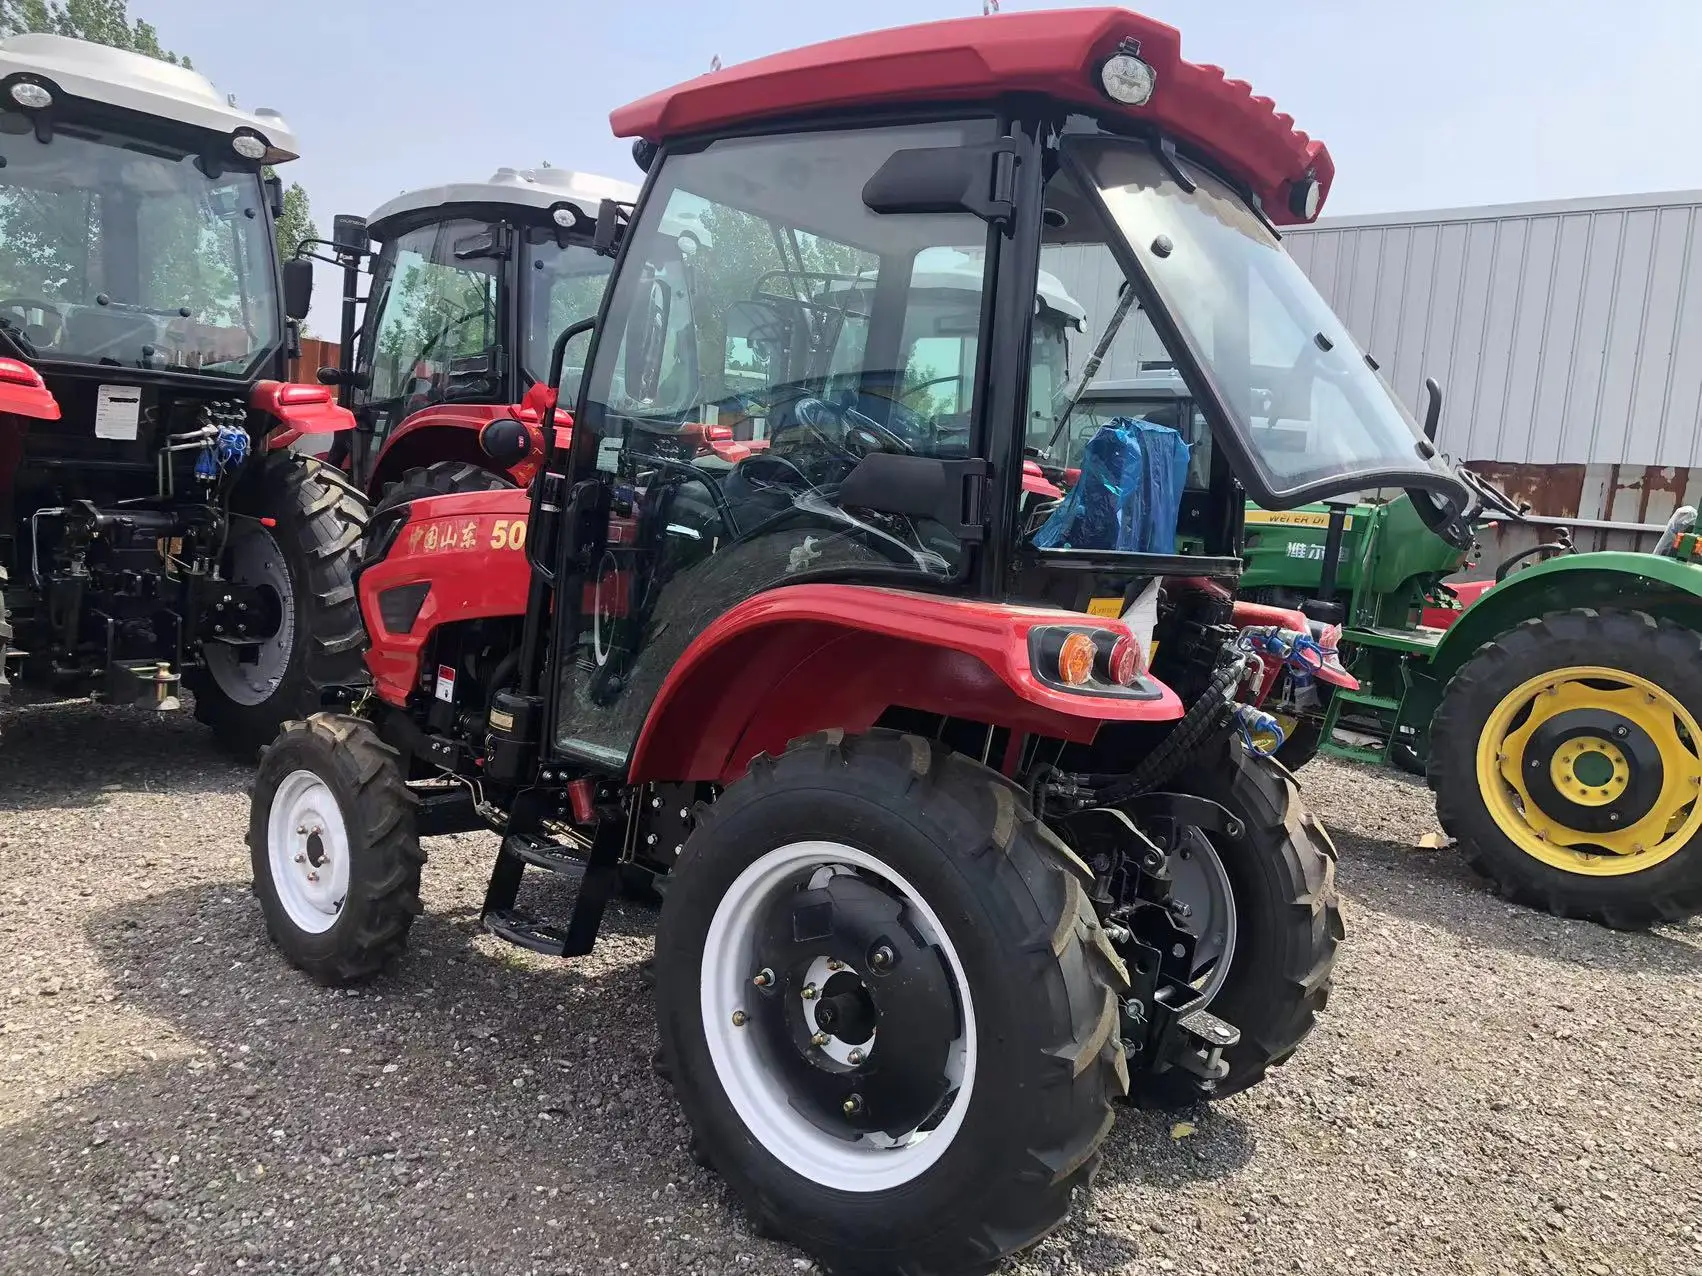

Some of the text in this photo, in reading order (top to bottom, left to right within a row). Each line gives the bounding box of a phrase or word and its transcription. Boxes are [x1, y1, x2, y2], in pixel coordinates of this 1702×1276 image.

[408, 519, 528, 553] 中国山东 50
